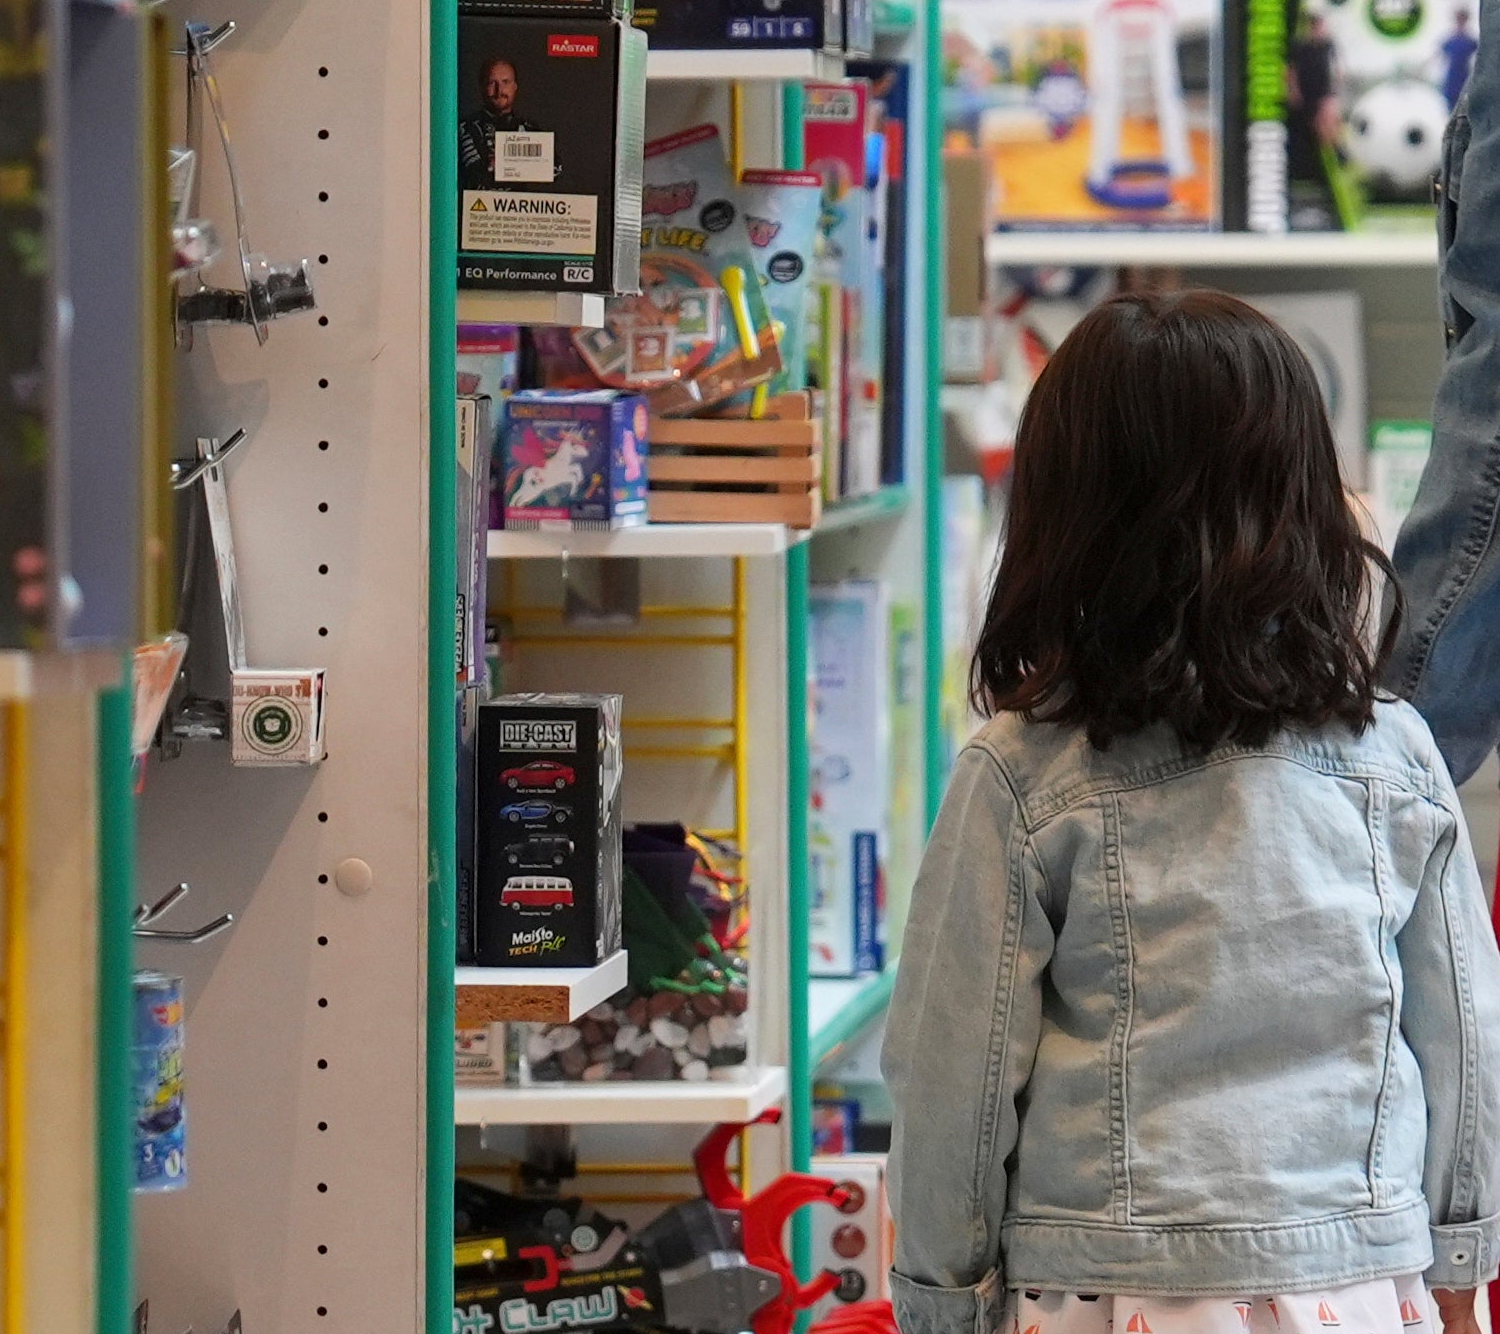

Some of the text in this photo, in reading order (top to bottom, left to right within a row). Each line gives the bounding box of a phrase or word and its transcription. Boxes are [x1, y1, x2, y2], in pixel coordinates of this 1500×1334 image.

[551, 42, 595, 53] RASTAR
[493, 198, 572, 215] WARNING:
[465, 267, 483, 279] EQ
[486, 267, 557, 281] Performance
[567, 269, 590, 280] R/C
[503, 723, 574, 742] DIE-CAST
[511, 926, 554, 947] Maisto
[508, 944, 537, 957] TECH
